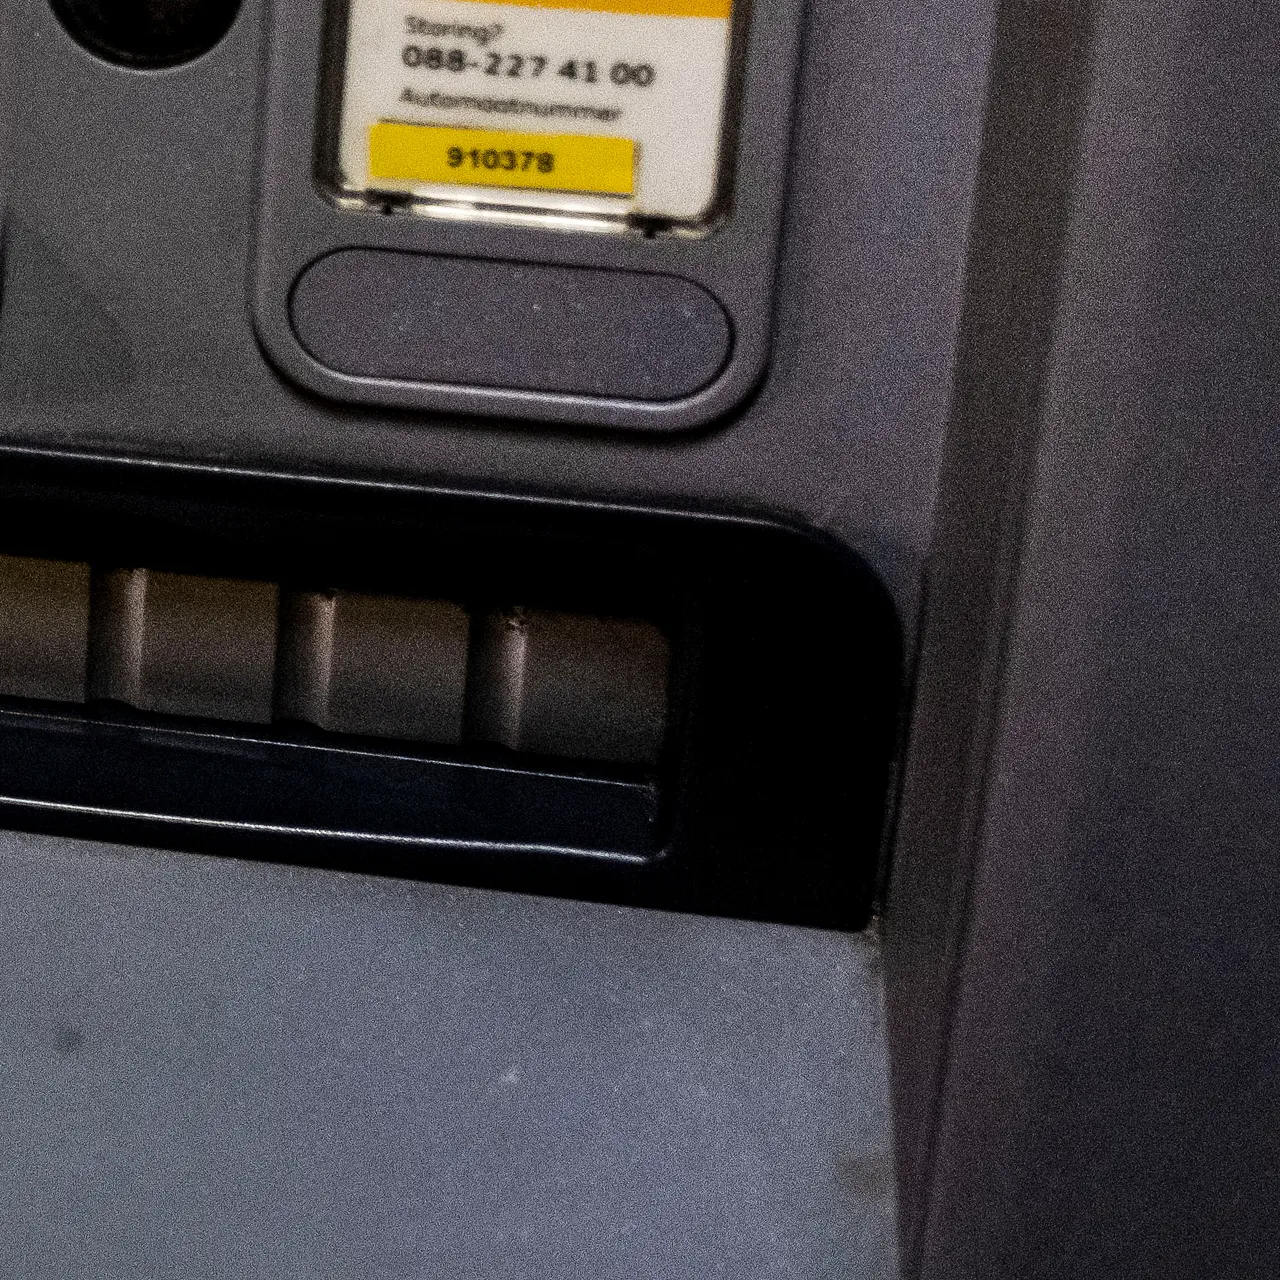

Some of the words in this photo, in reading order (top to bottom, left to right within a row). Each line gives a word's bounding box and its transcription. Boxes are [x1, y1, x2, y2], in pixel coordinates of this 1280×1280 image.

[405, 15, 505, 45] Storing?
[401, 44, 548, 79] 088-227
[560, 59, 598, 83] 41
[611, 62, 656, 88] 00
[399, 87, 623, 121] Automaatnummer
[447, 146, 556, 174] 910378
